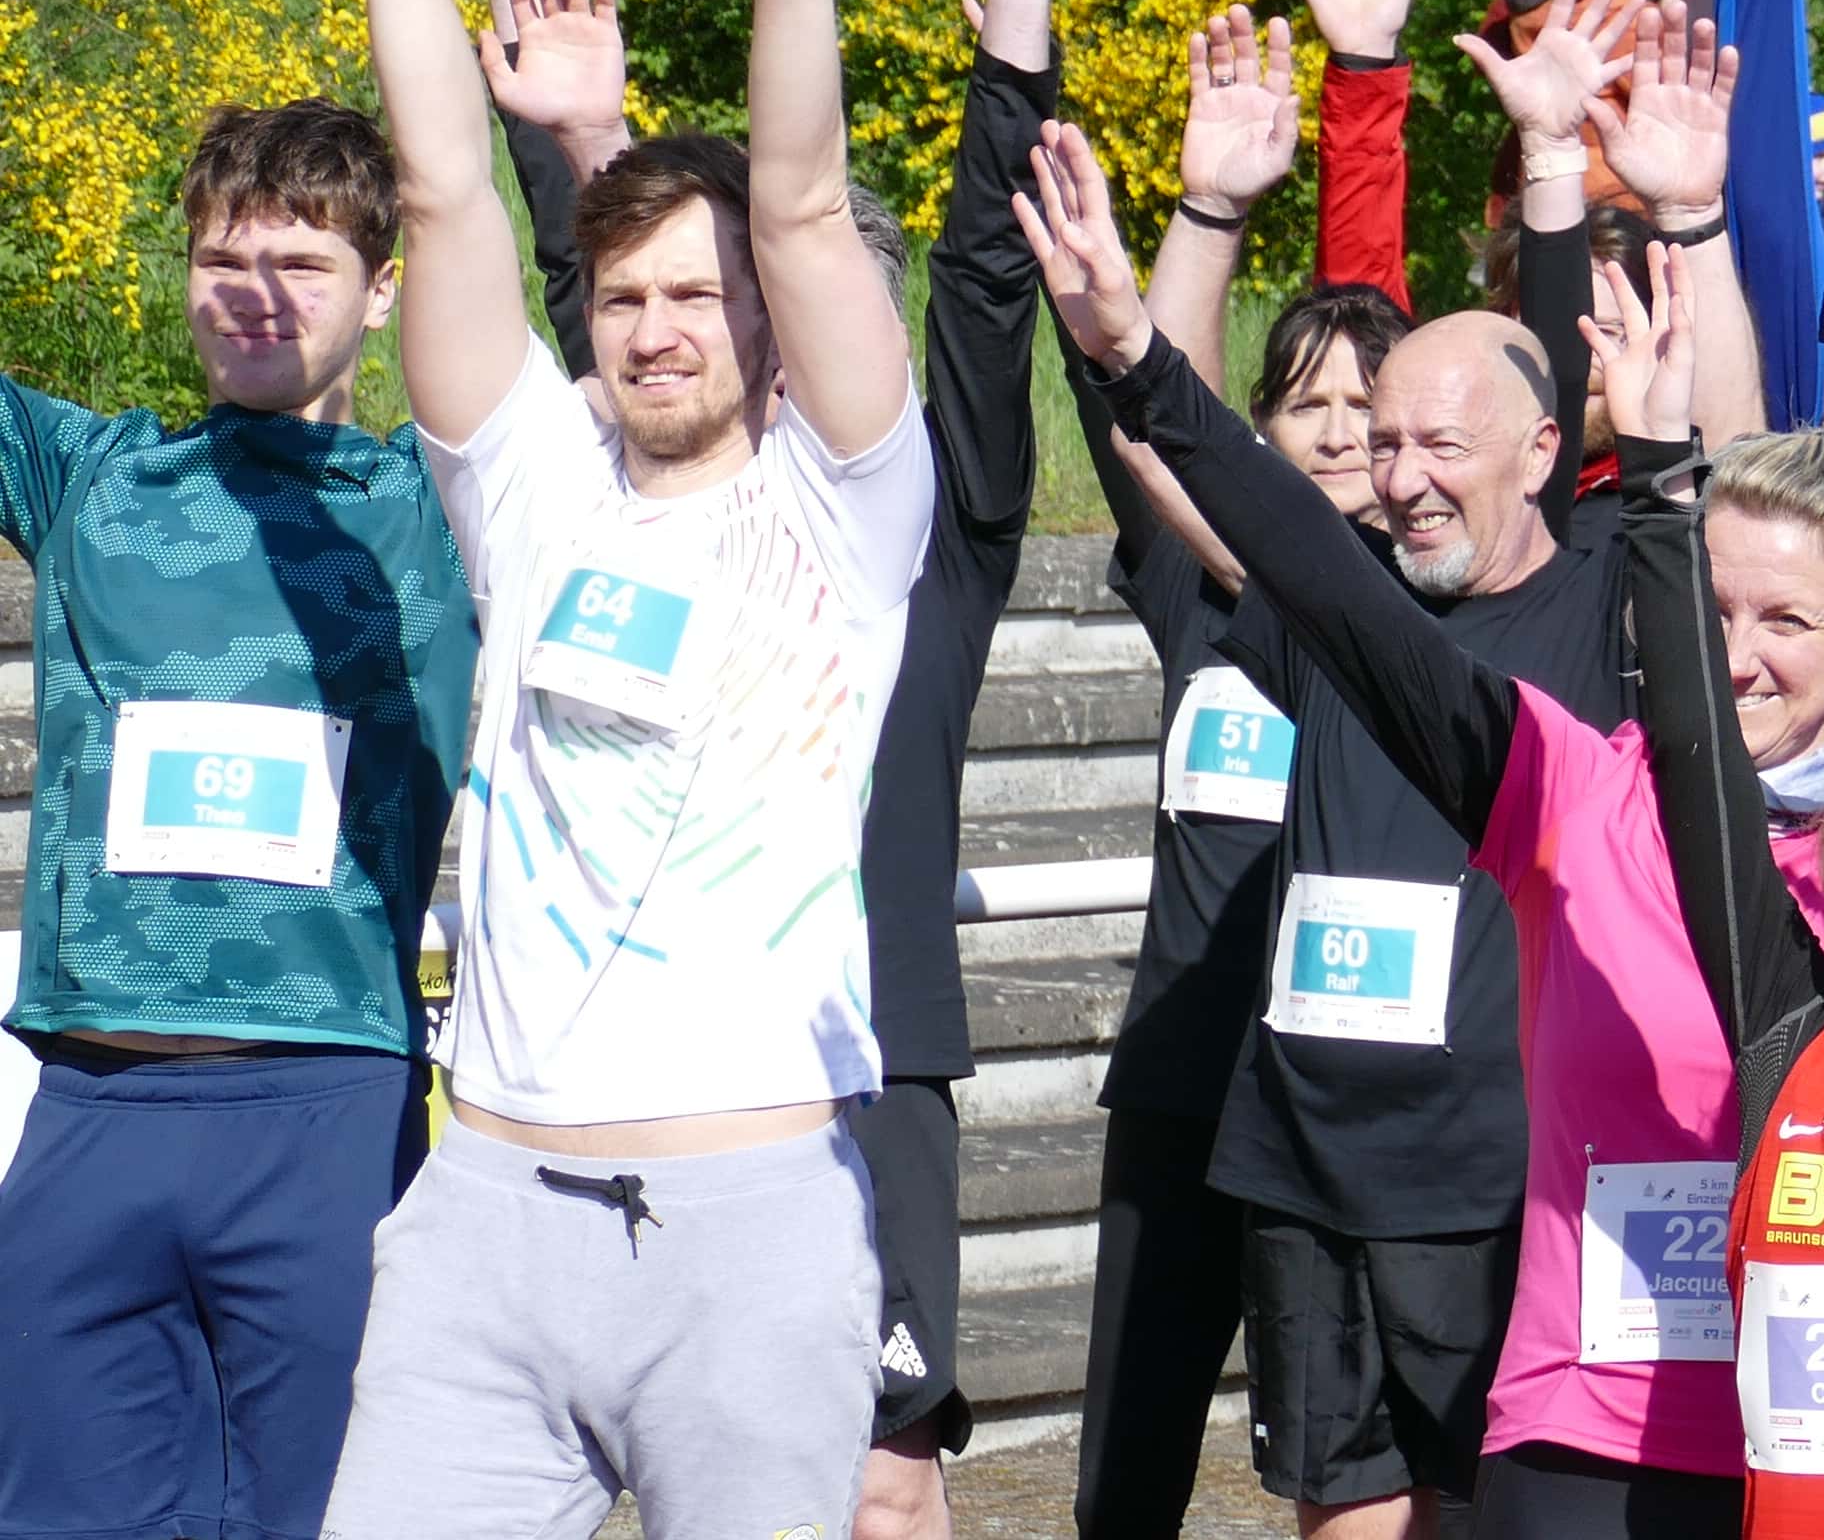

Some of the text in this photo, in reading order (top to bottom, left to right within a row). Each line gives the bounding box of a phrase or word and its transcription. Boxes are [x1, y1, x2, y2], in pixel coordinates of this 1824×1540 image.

[577, 574, 638, 627] 64
[1219, 713, 1263, 752] 51
[193, 756, 254, 800] 69
[1321, 927, 1369, 968] 60
[1700, 1179, 1728, 1190] 5 km
[1663, 1216, 1727, 1261] 22
